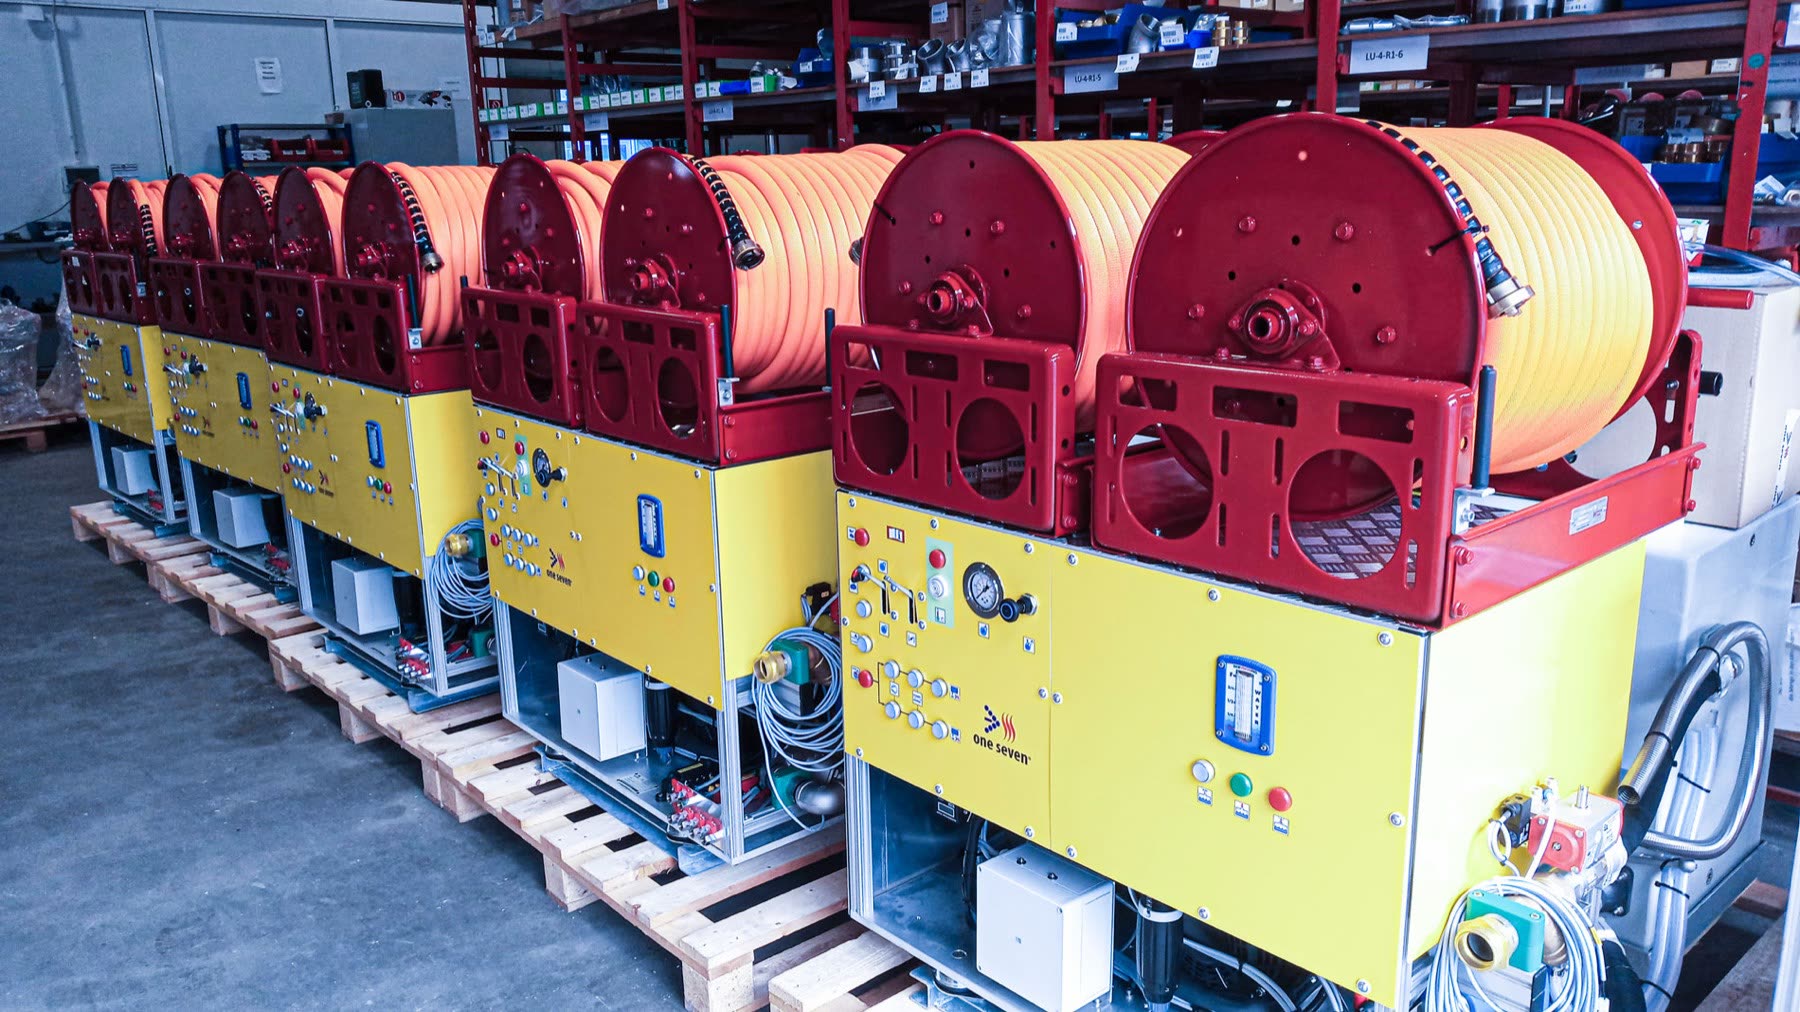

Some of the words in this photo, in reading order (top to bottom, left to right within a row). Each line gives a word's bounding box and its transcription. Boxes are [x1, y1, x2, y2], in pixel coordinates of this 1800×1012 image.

[1365, 49, 1404, 61] LU-4-R1-6
[1074, 73, 1102, 83] LU-4-R1-5
[973, 733, 993, 750] one
[996, 743, 1028, 766] seven
